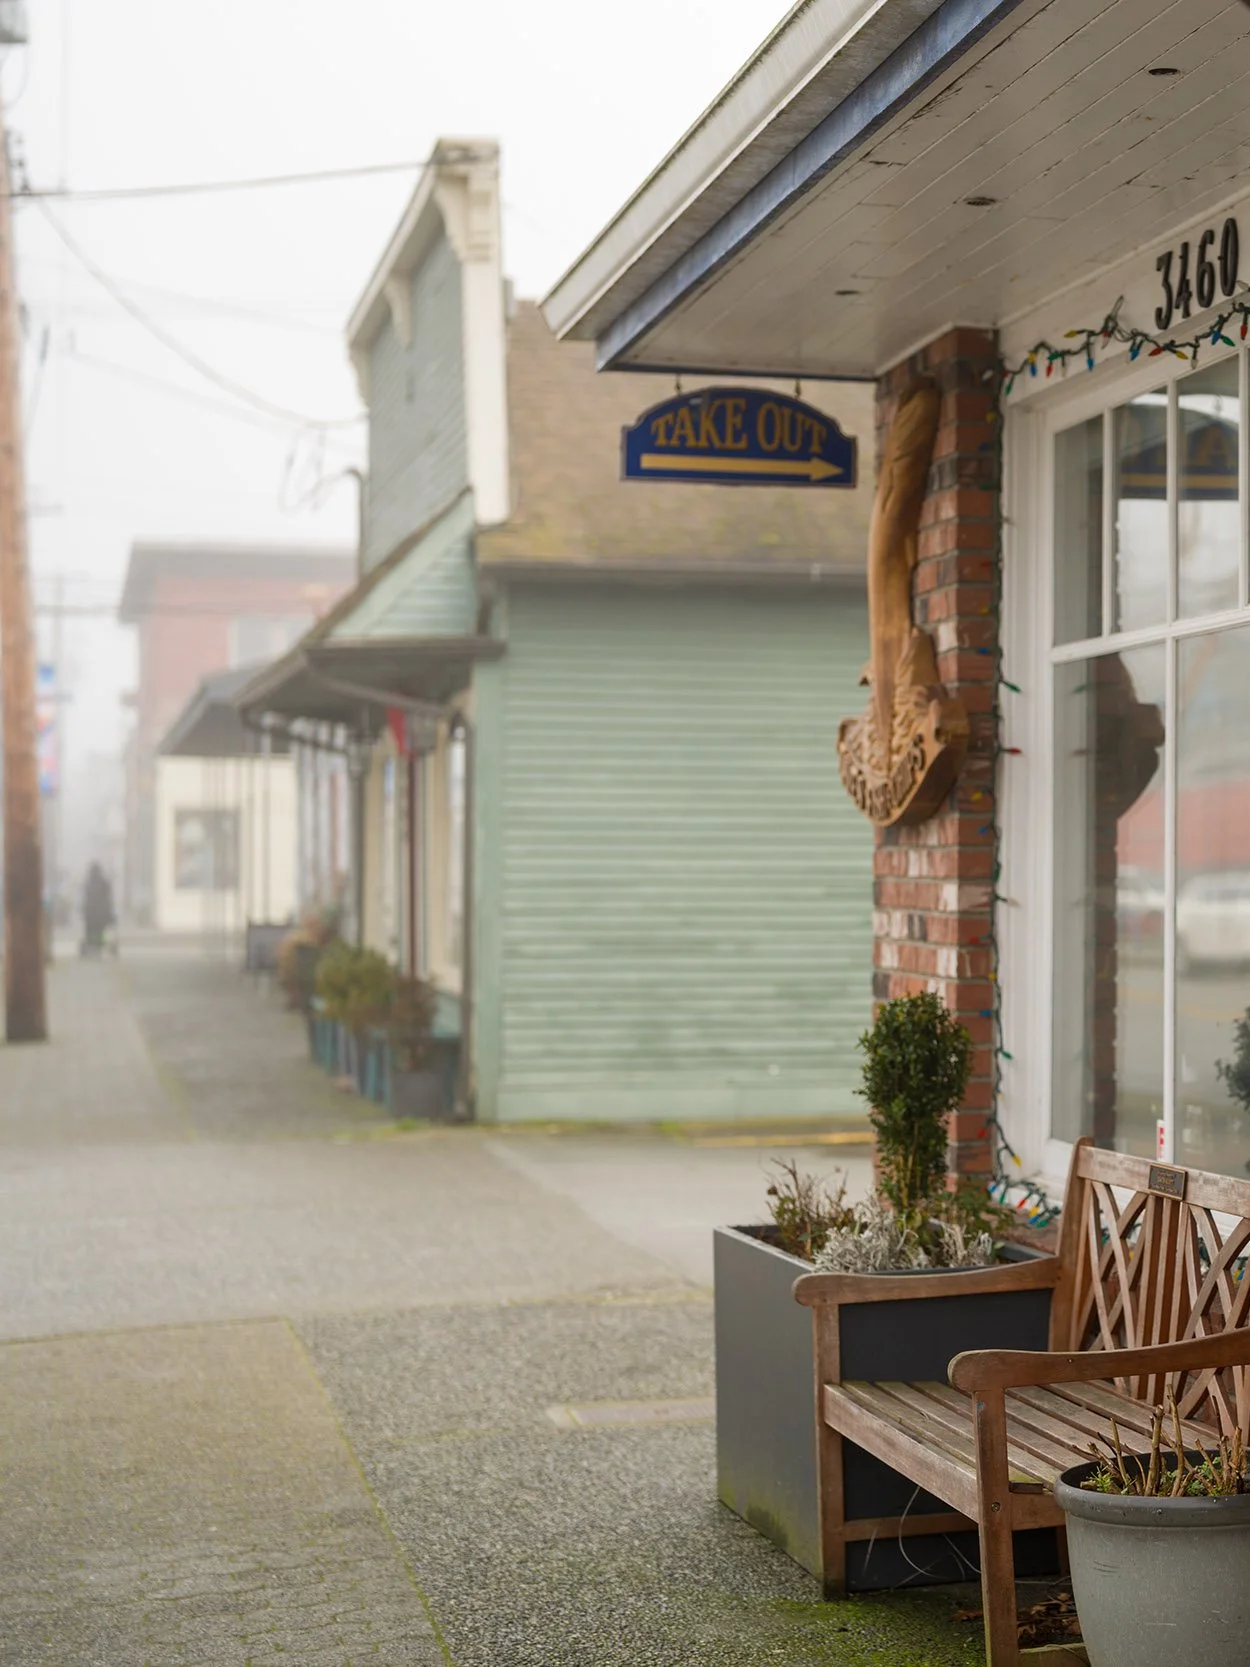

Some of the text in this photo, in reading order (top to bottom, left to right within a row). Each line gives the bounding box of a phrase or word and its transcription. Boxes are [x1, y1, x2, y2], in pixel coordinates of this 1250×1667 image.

[1155, 217, 1239, 330] 3460
[652, 397, 828, 454] TAKE OUT
